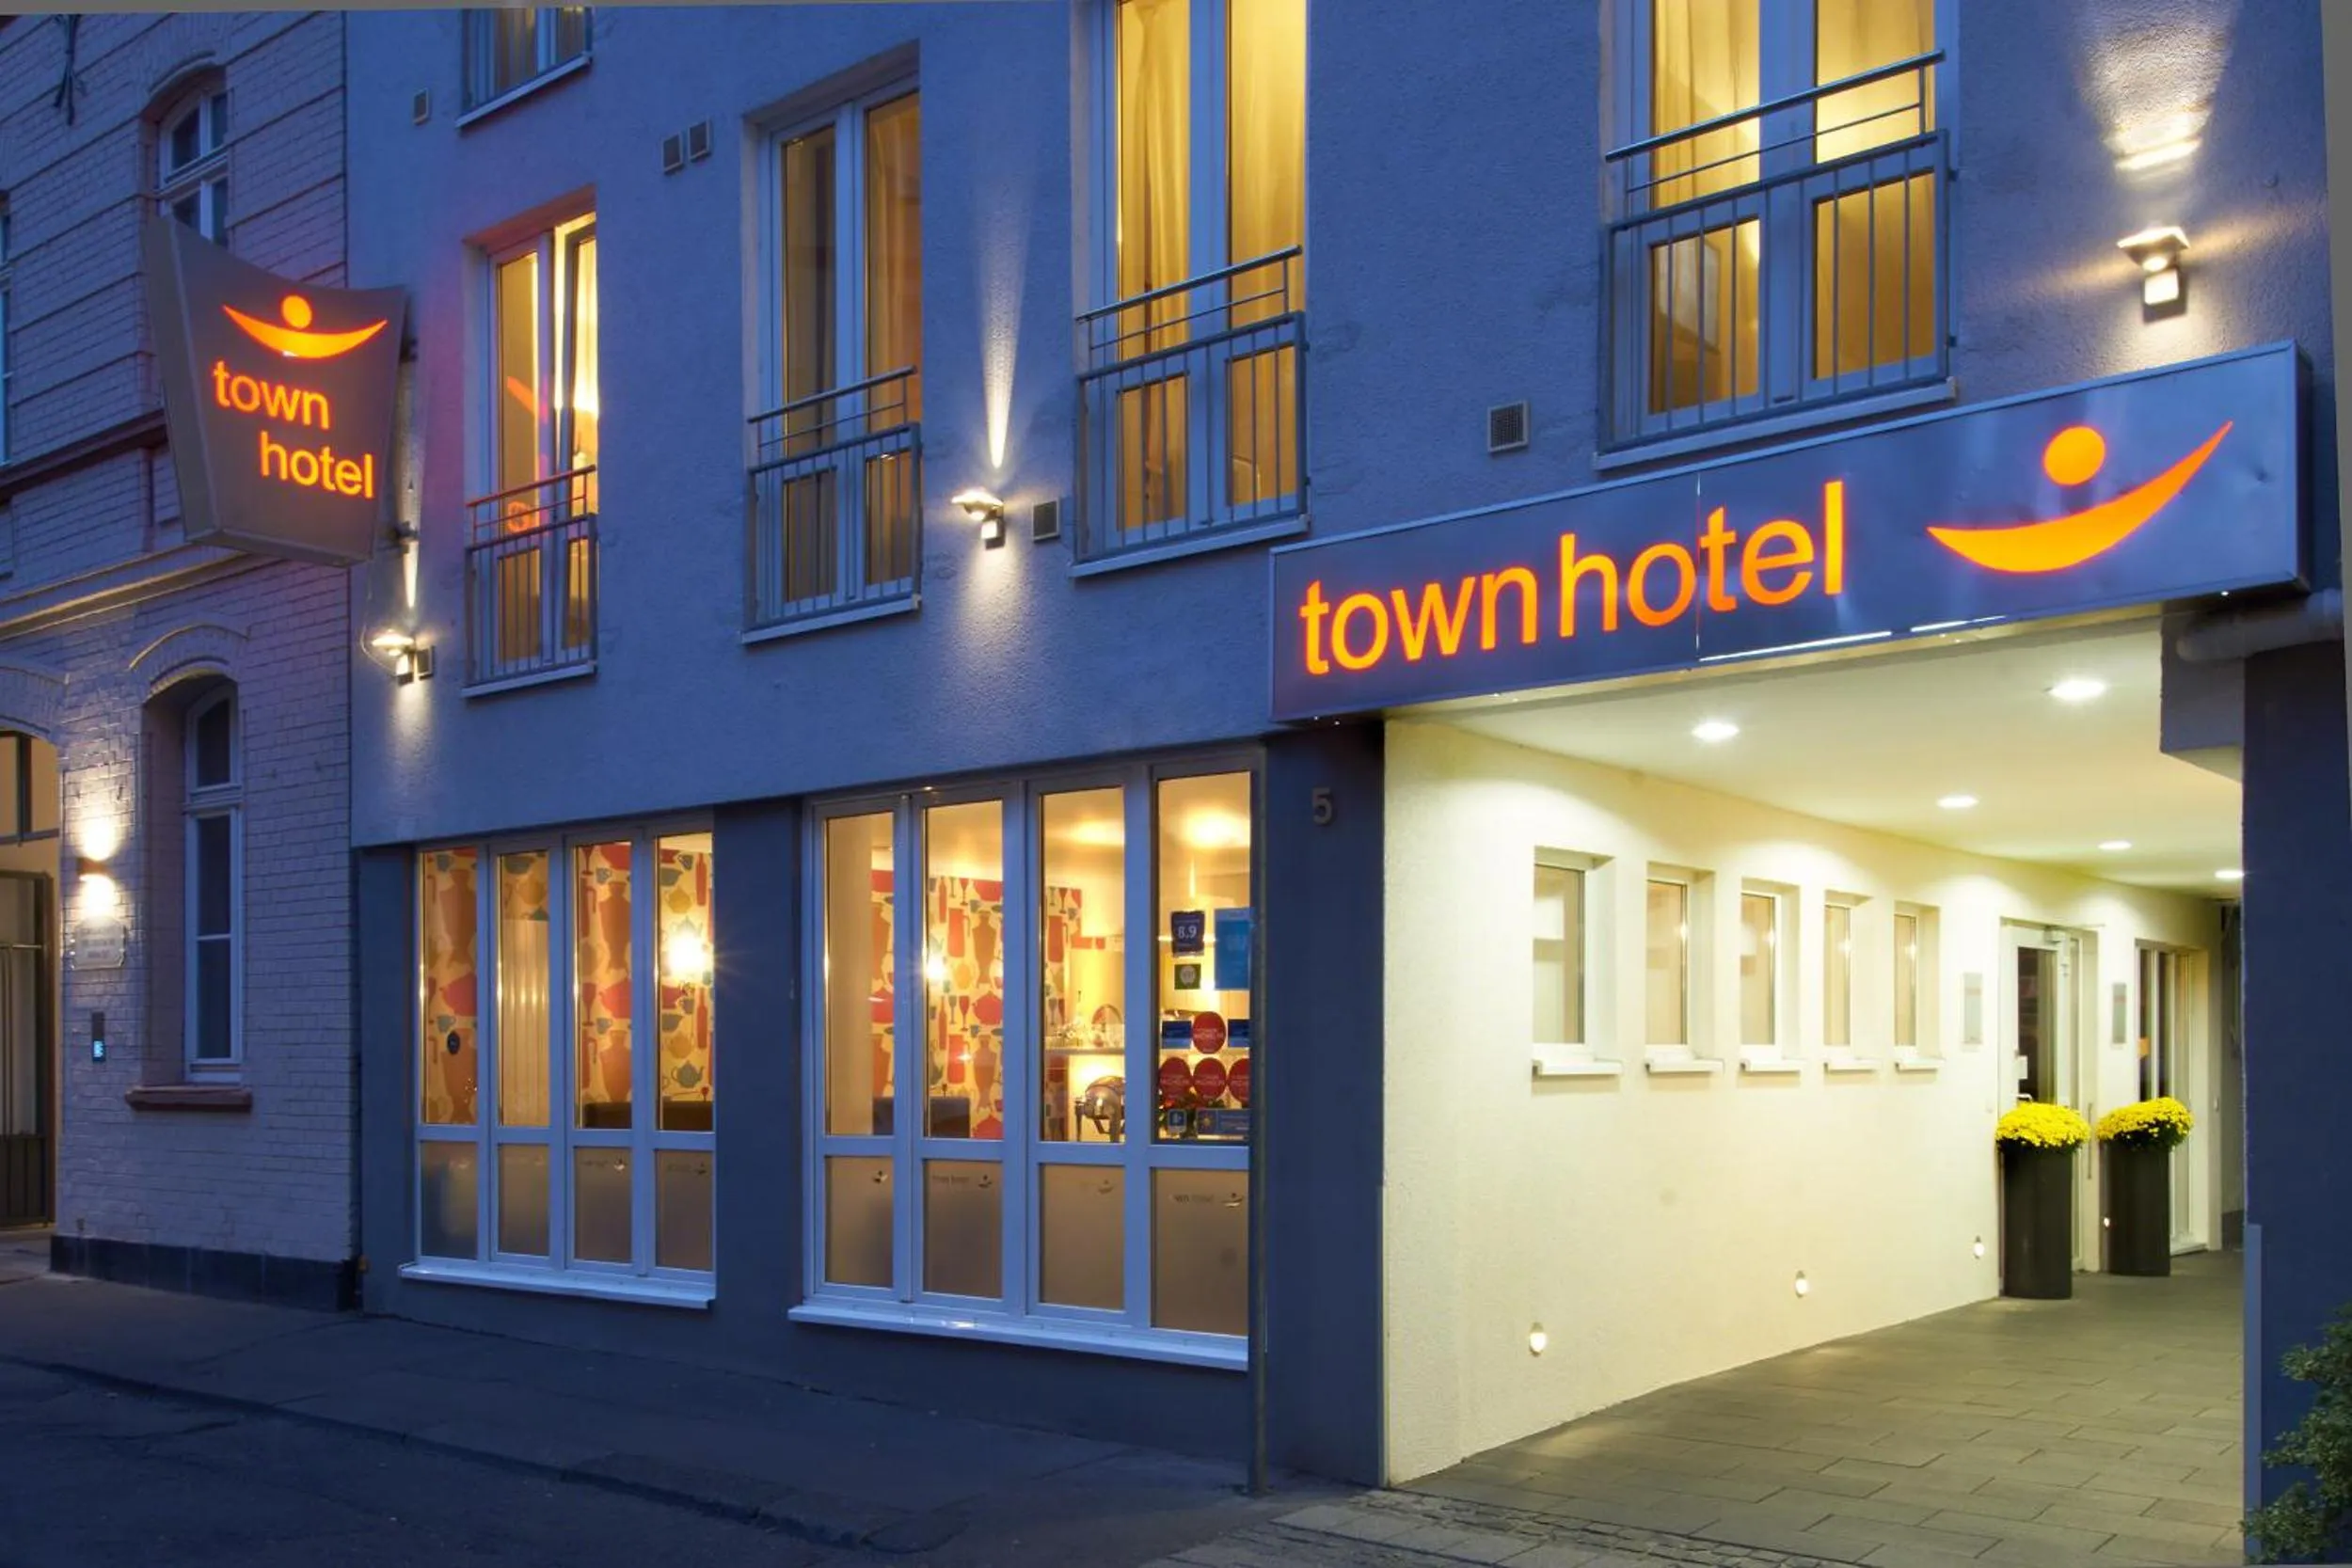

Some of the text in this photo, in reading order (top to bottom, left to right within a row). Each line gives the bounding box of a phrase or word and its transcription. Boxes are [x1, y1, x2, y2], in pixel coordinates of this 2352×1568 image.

[212, 359, 331, 430] town
[259, 430, 374, 499] hotel
[1311, 786, 1332, 825] 5
